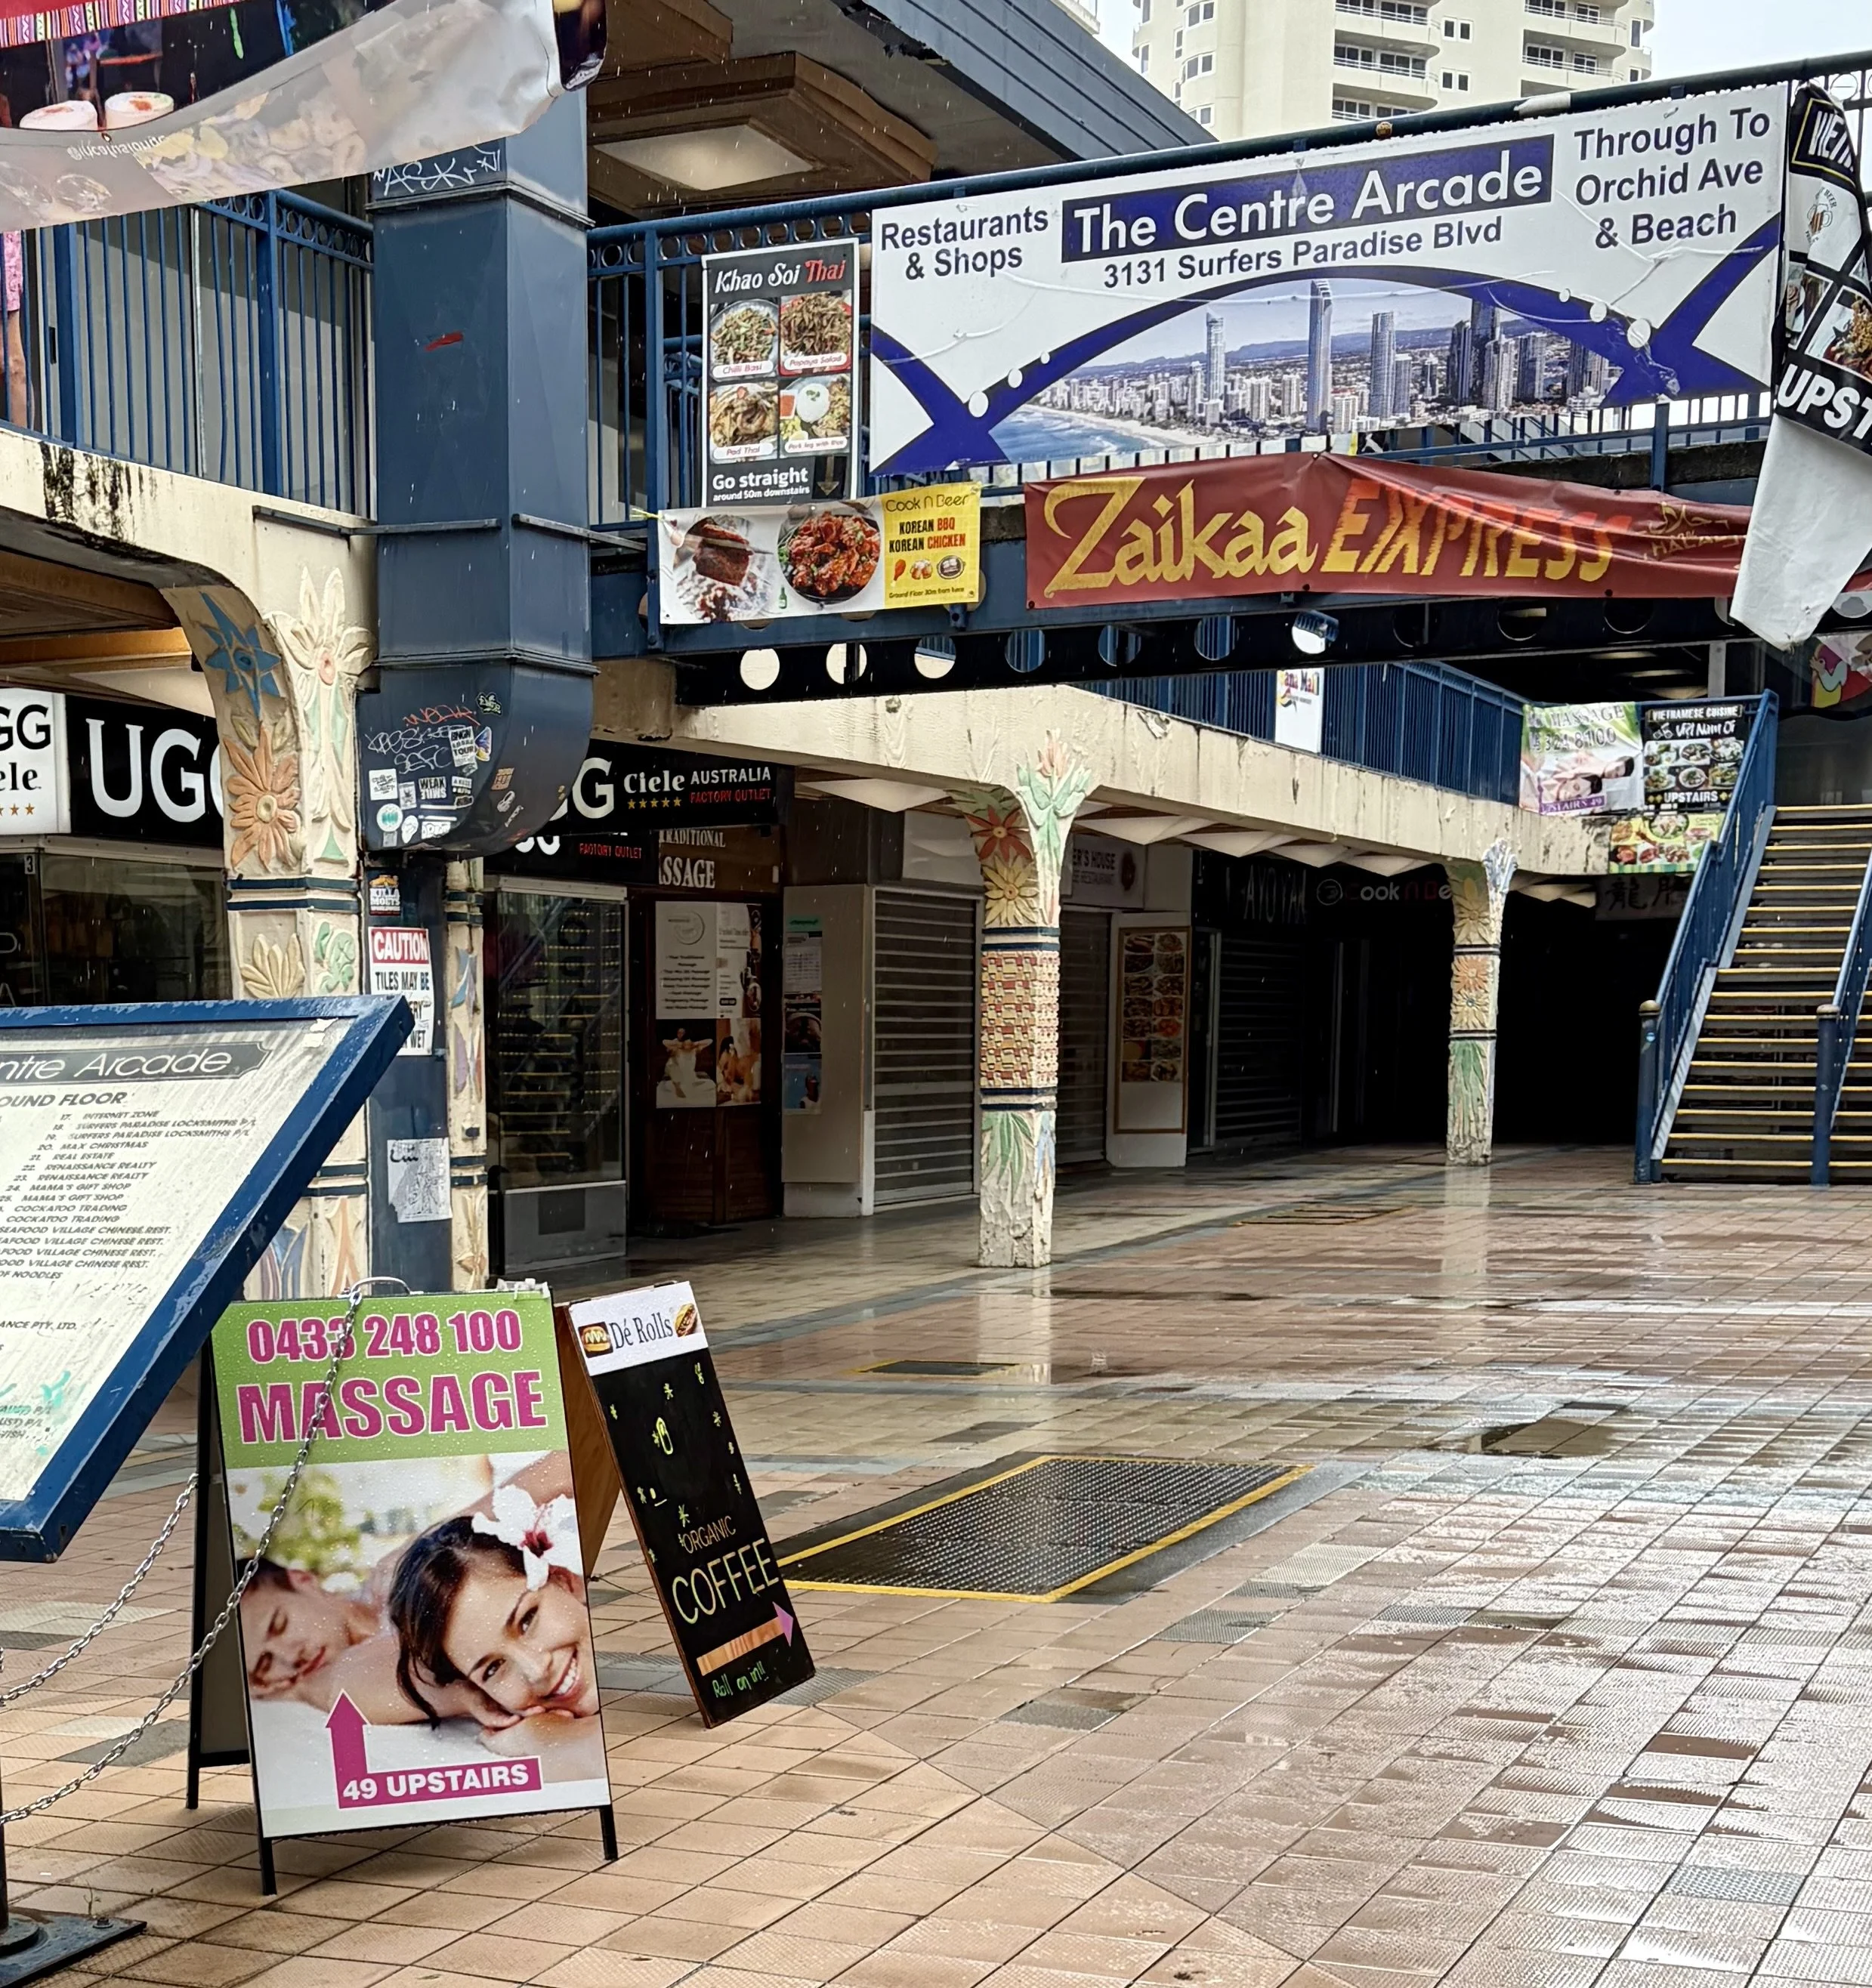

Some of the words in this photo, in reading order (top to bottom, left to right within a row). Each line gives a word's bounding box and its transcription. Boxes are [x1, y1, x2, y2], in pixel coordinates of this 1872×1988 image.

[1574, 114, 1717, 161] Through
[1730, 106, 1770, 140] To
[1576, 159, 1688, 205] Orchid
[1697, 158, 1763, 190] Ave
[1074, 203, 1157, 253] The
[1174, 189, 1334, 239] Centre
[1351, 150, 1543, 216] Arcade
[881, 206, 1049, 250] Restaurants
[1595, 218, 1618, 248] &
[1632, 204, 1737, 245] Beach
[906, 252, 925, 280] &
[934, 247, 1022, 278] Shops
[1104, 258, 1166, 289] 3131
[1178, 248, 1282, 280] Surfers
[1293, 227, 1423, 266] Paradise
[1435, 216, 1502, 248] Blvd
[715, 269, 763, 293] Khao
[768, 262, 801, 286] Soi
[805, 259, 846, 283] Thai
[712, 474, 735, 489] Go
[739, 467, 808, 487] straight
[713, 490, 742, 502] around
[743, 489, 762, 499] 50m
[764, 486, 810, 497] downstairs
[885, 497, 921, 512] Cook
[936, 494, 968, 508] Beer
[899, 519, 934, 535] KOREAN
[937, 517, 956, 531] BBQ
[1043, 477, 1319, 599] Zaikaa
[1320, 479, 1632, 582] EXPRESS
[889, 537, 925, 553] KOREAN
[927, 533, 965, 549] CHICKEN
[86, 718, 224, 823] UG
[624, 770, 685, 794] Ciele
[690, 767, 771, 785] AUSTRALIA
[690, 789, 732, 803] FACTORY
[735, 788, 771, 801] OUTLET
[1663, 791, 1719, 803] UPSTAIRS
[26, 855, 33, 873] 3
[615, 846, 642, 860] OUTLET
[374, 931, 428, 961] CAUTION
[375, 971, 398, 991] TILES
[401, 971, 417, 990] MAY
[420, 972, 430, 991] BE
[73, 1048, 232, 1078] Arcade
[58, 1092, 128, 1106] FLOOR
[112, 1130, 163, 1139] PARADISE
[165, 1129, 231, 1138] LOCKSMITHS
[119, 1120, 171, 1129] PARADISE
[82, 1249, 129, 1257] CHINESE
[12, 1271, 63, 1280] NOODLES
[247, 1315, 355, 1364] 0433
[364, 1311, 441, 1359] 248
[449, 1308, 522, 1354] 100
[609, 1318, 633, 1349] Dé
[632, 1312, 673, 1344] Rolls
[236, 1369, 548, 1444] MASSAGE
[682, 1515, 736, 1554] ORGANIC
[672, 1538, 780, 1624] COFFEE
[712, 1674, 734, 1698] Roll
[343, 1778, 378, 1801] 49
[386, 1764, 530, 1797] UPSTAIRS
